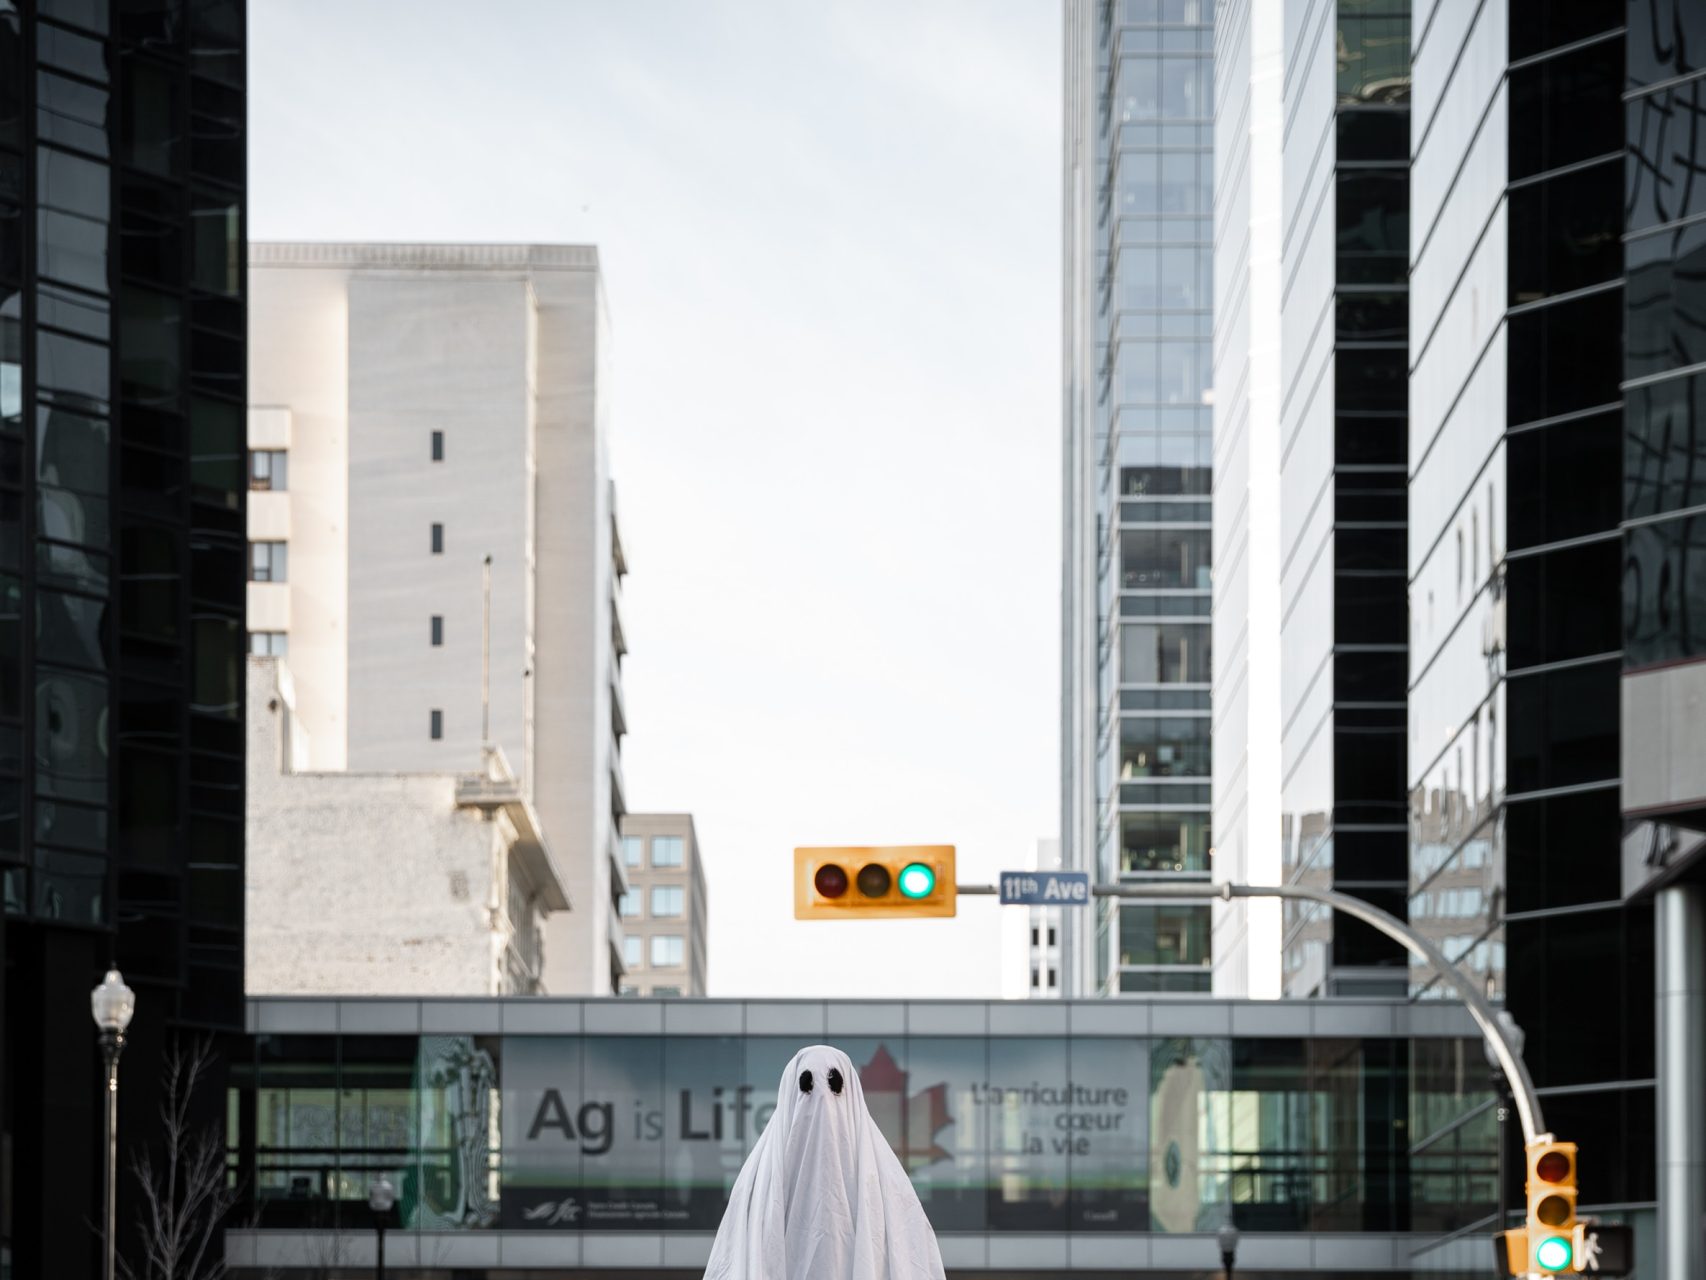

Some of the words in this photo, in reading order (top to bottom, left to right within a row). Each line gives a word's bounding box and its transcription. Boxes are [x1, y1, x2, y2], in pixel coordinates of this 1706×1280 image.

[1003, 877, 1038, 900] 11th
[1044, 877, 1086, 900] Ave
[527, 1087, 614, 1155] Ag
[634, 1101, 663, 1140] is
[1054, 1112, 1124, 1131] cœur
[1052, 1135, 1090, 1156] vie
